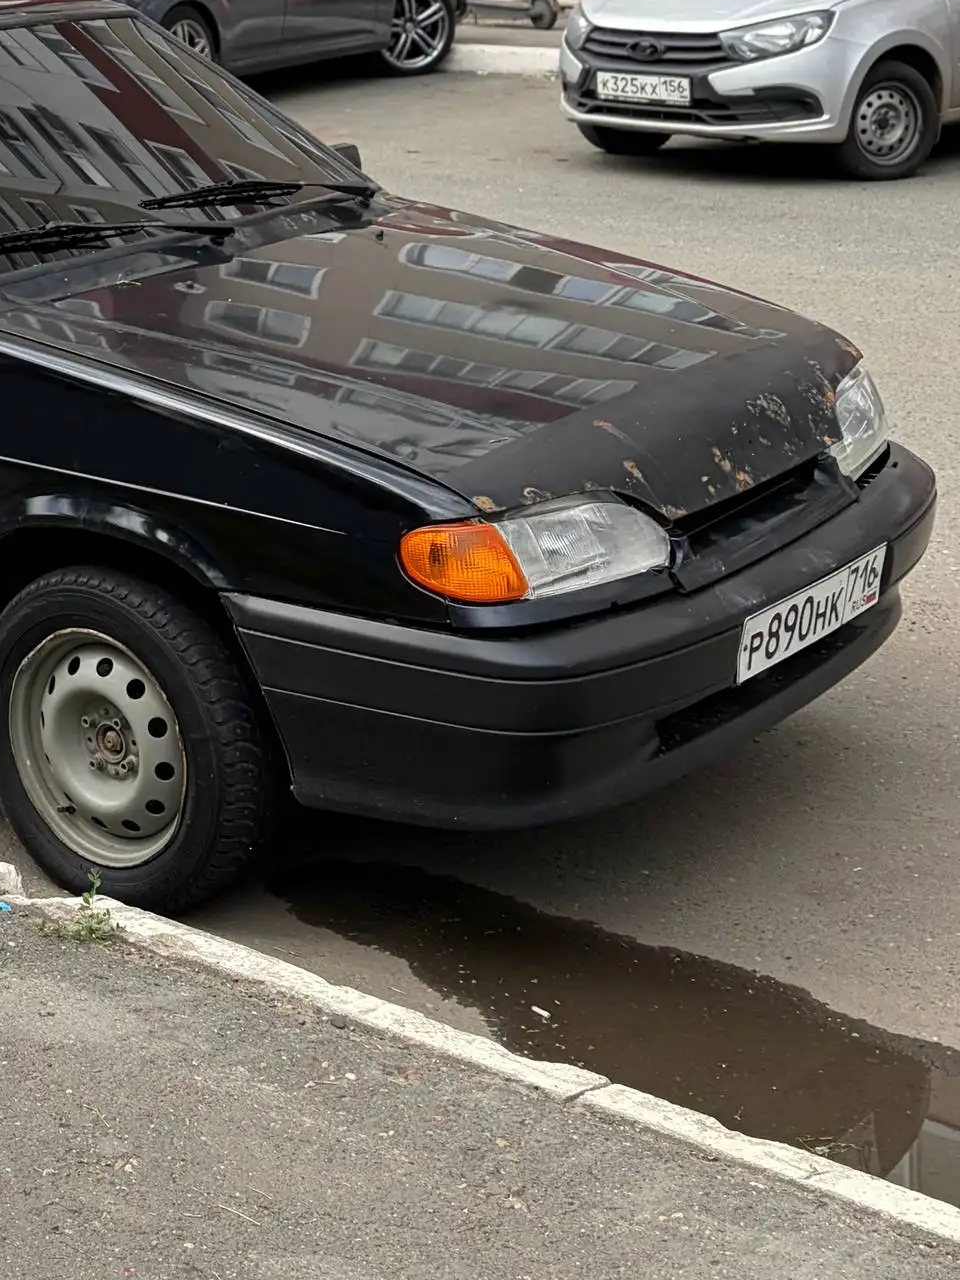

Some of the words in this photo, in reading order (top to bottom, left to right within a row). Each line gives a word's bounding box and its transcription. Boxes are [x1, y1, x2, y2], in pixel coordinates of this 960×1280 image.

[601, 76, 659, 96] К325КХ
[662, 80, 687, 94] 156
[747, 586, 844, 671] Р890НК
[848, 555, 878, 602] 716
